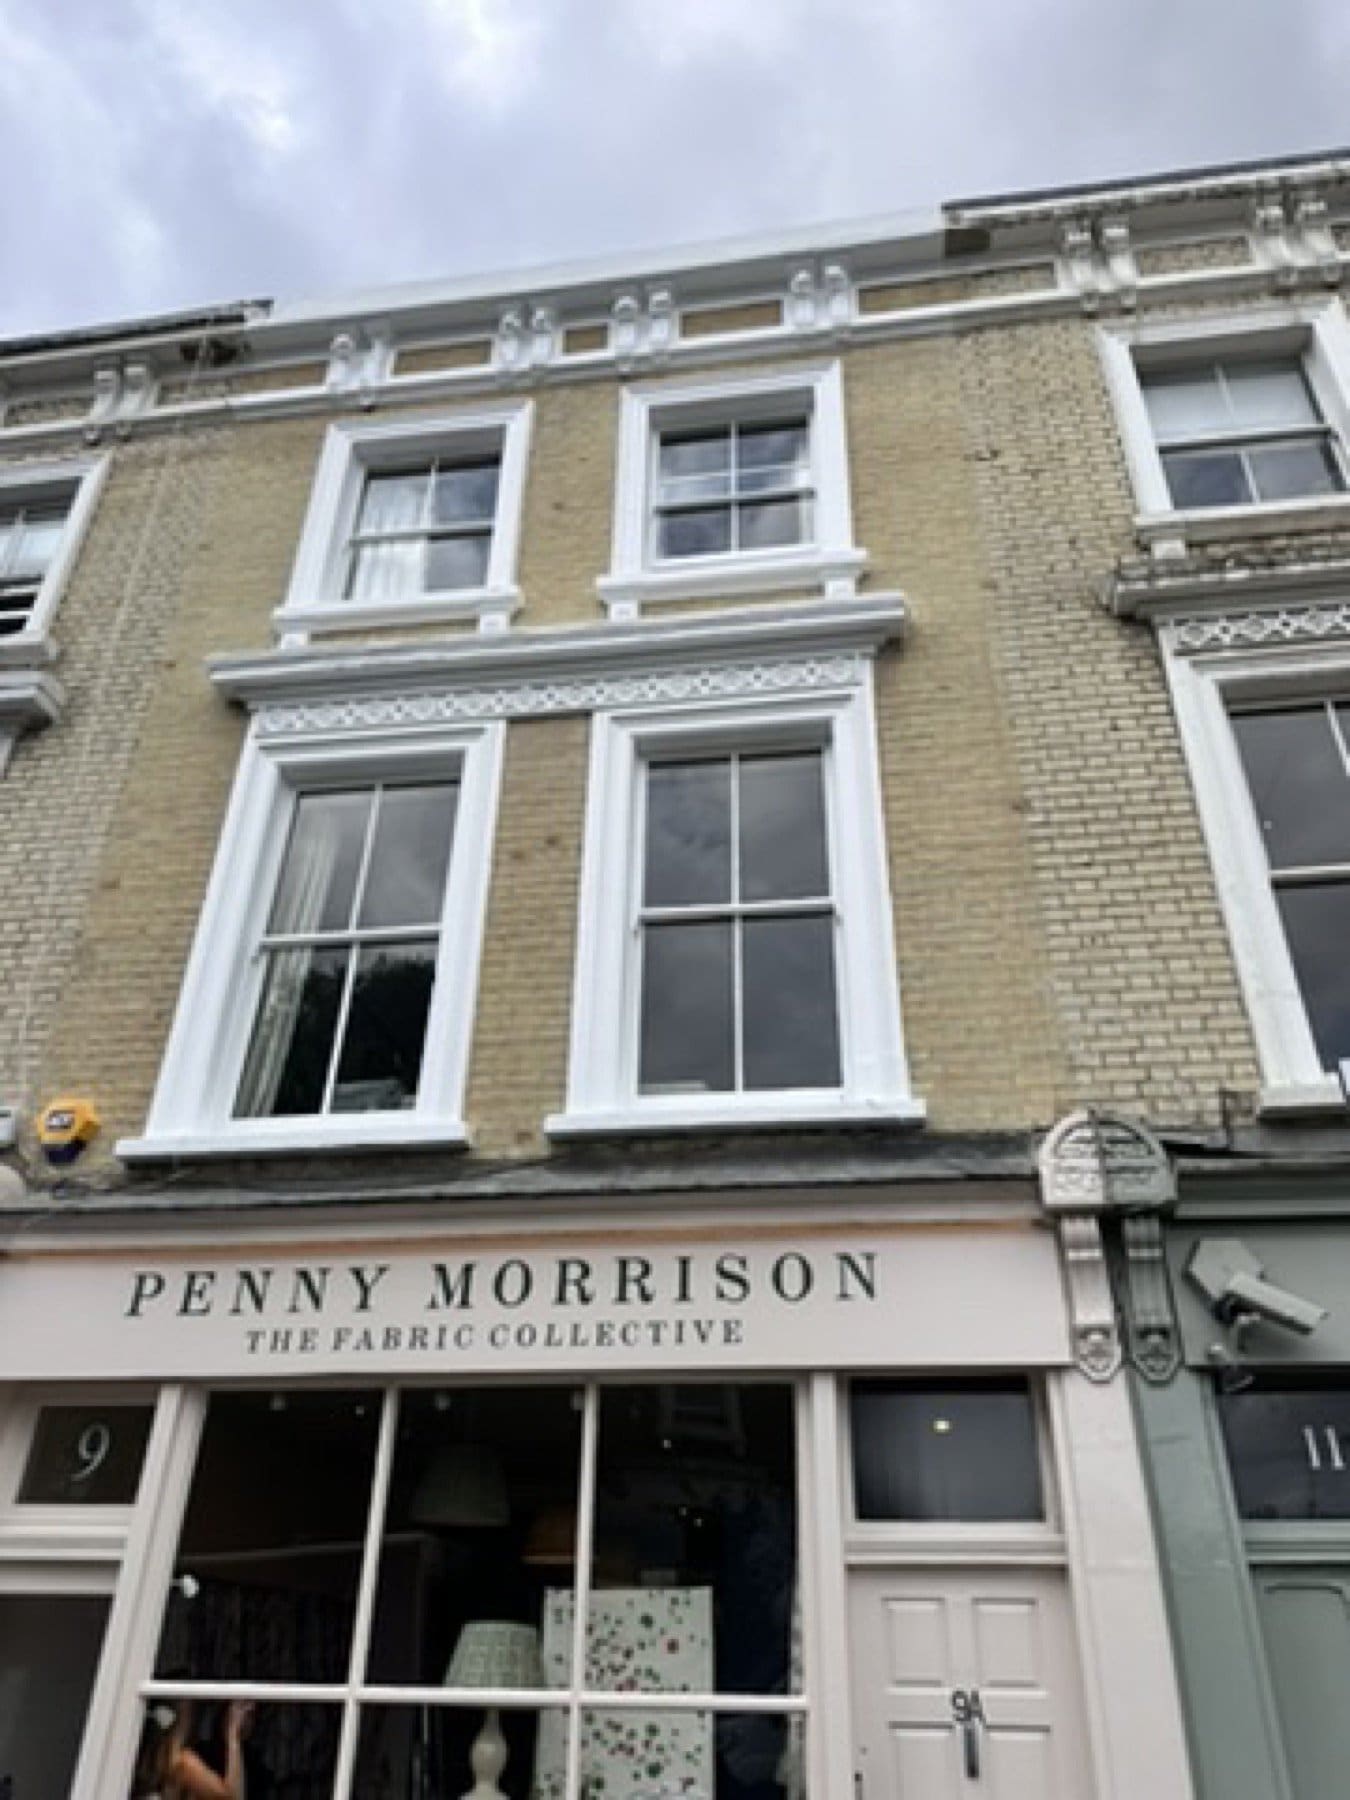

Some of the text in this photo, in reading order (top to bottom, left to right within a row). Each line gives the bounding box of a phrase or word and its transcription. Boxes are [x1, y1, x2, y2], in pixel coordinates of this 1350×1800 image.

[124, 1252, 879, 1317] PENNY MORRISON
[246, 1319, 743, 1354] THE FABRIC COLLECTIVE
[70, 1423, 110, 1481] 9
[1301, 1424, 1346, 1471] 11
[951, 1690, 987, 1727] 9A
